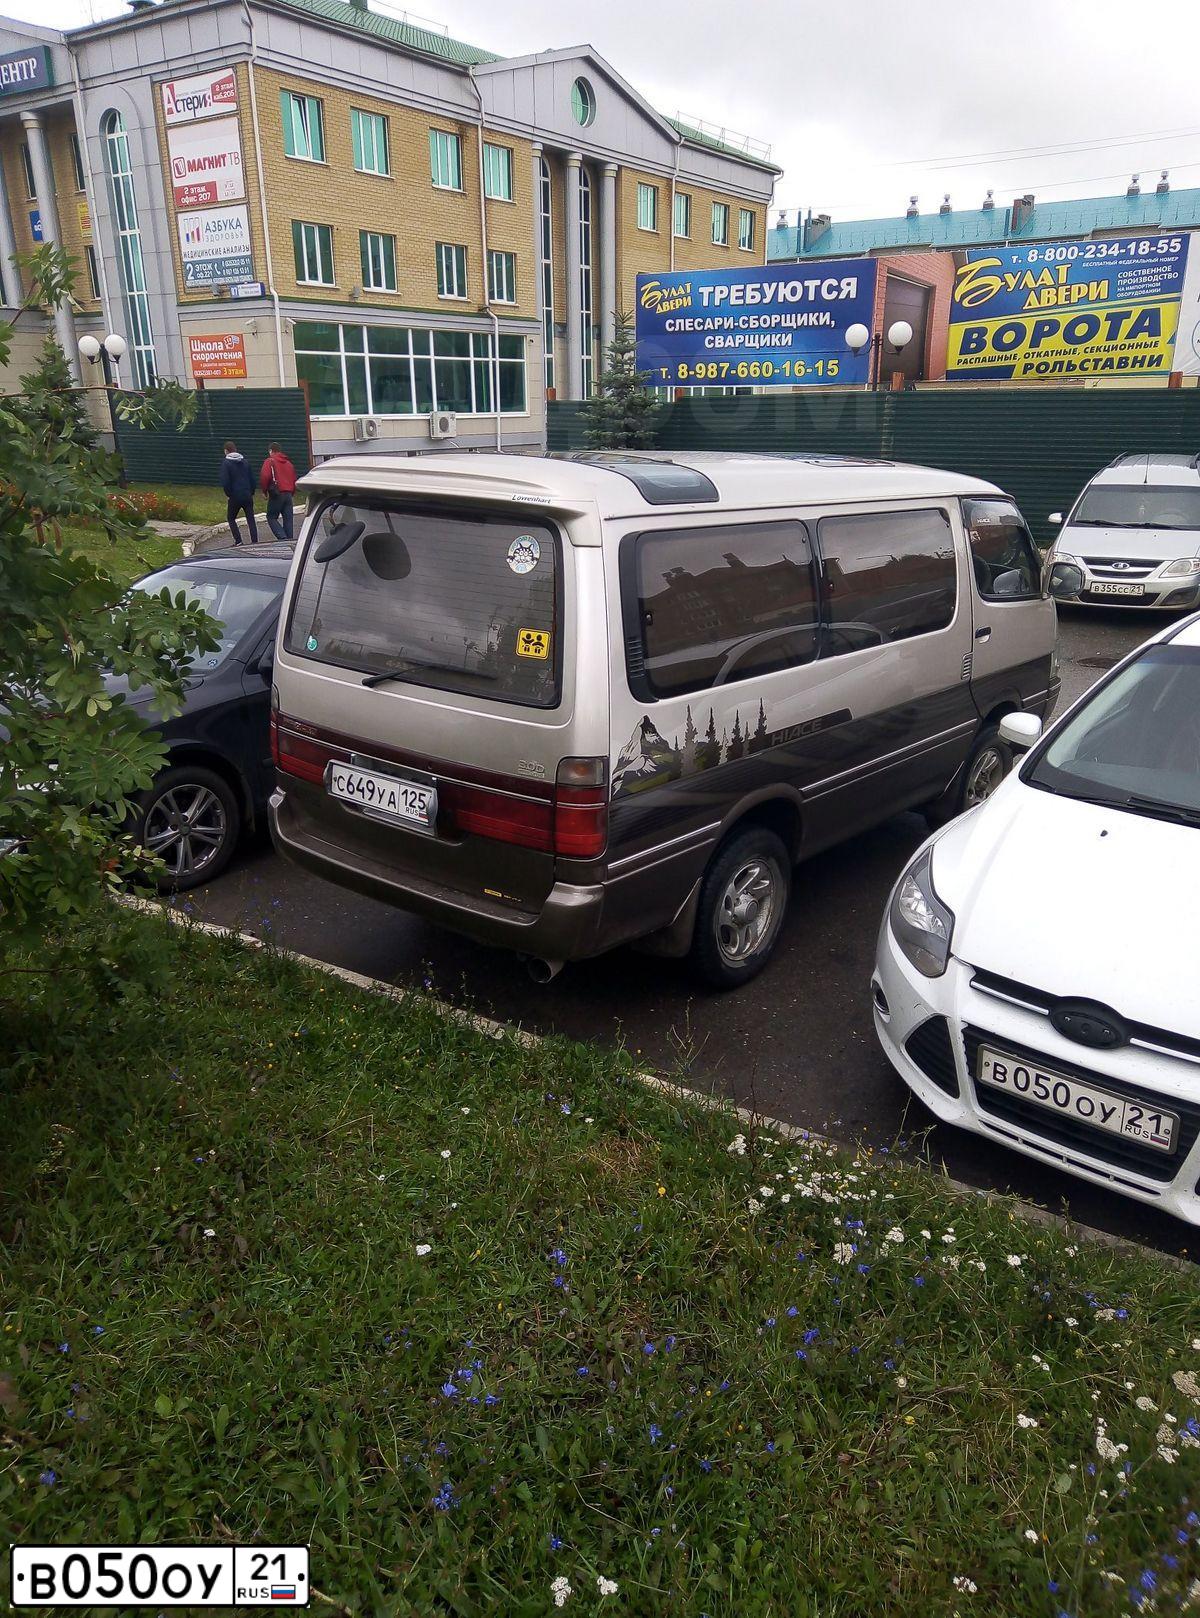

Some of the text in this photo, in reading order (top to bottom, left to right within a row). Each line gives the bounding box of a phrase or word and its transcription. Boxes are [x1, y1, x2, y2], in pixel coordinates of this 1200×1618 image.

[0, 57, 37, 89] ЕНТР
[186, 151, 240, 173] МАГНИТ ТВ
[180, 192, 211, 204] офис 207
[184, 185, 207, 195] 2 этаж
[205, 217, 243, 233] АЗБУКА
[1027, 238, 1182, 264] 8-800-234-18-55
[186, 262, 195, 280] 2
[1083, 259, 1118, 267] БЕСПЛАТНЫЙ
[1119, 257, 1159, 265] ФЕДЕРАЛЬНЫЙ
[1118, 265, 1172, 279] СОБСТВЕННОЕ
[1118, 272, 1179, 286] ПРОИЗВОДСТВО
[699, 277, 858, 307] ТРЕБУЮТСЯ
[1023, 279, 1109, 310] ДВЕРИ
[656, 296, 692, 314] ДВЕРИ
[665, 312, 836, 332] СЛЕСАРИ-СБОРЩИКИ,
[959, 307, 1161, 356] ВОРОТА
[191, 339, 224, 351] Школа
[704, 333, 793, 350] СВАРЩИКИ
[192, 351, 243, 362] скорочтения
[956, 340, 1160, 366] РАСПАШНЫЕ, ОТКАТНЫЕ, СЕКЦИОННЫЕ
[677, 359, 840, 379] 8-987-660-16-15
[1022, 354, 1164, 375] РОЛЬСТАВНИ
[771, 720, 821, 746] HIACE
[401, 789, 426, 810] 125
[405, 806, 419, 816] RUS
[1127, 1106, 1162, 1134] 21
[1124, 1124, 1149, 1139] RUS
